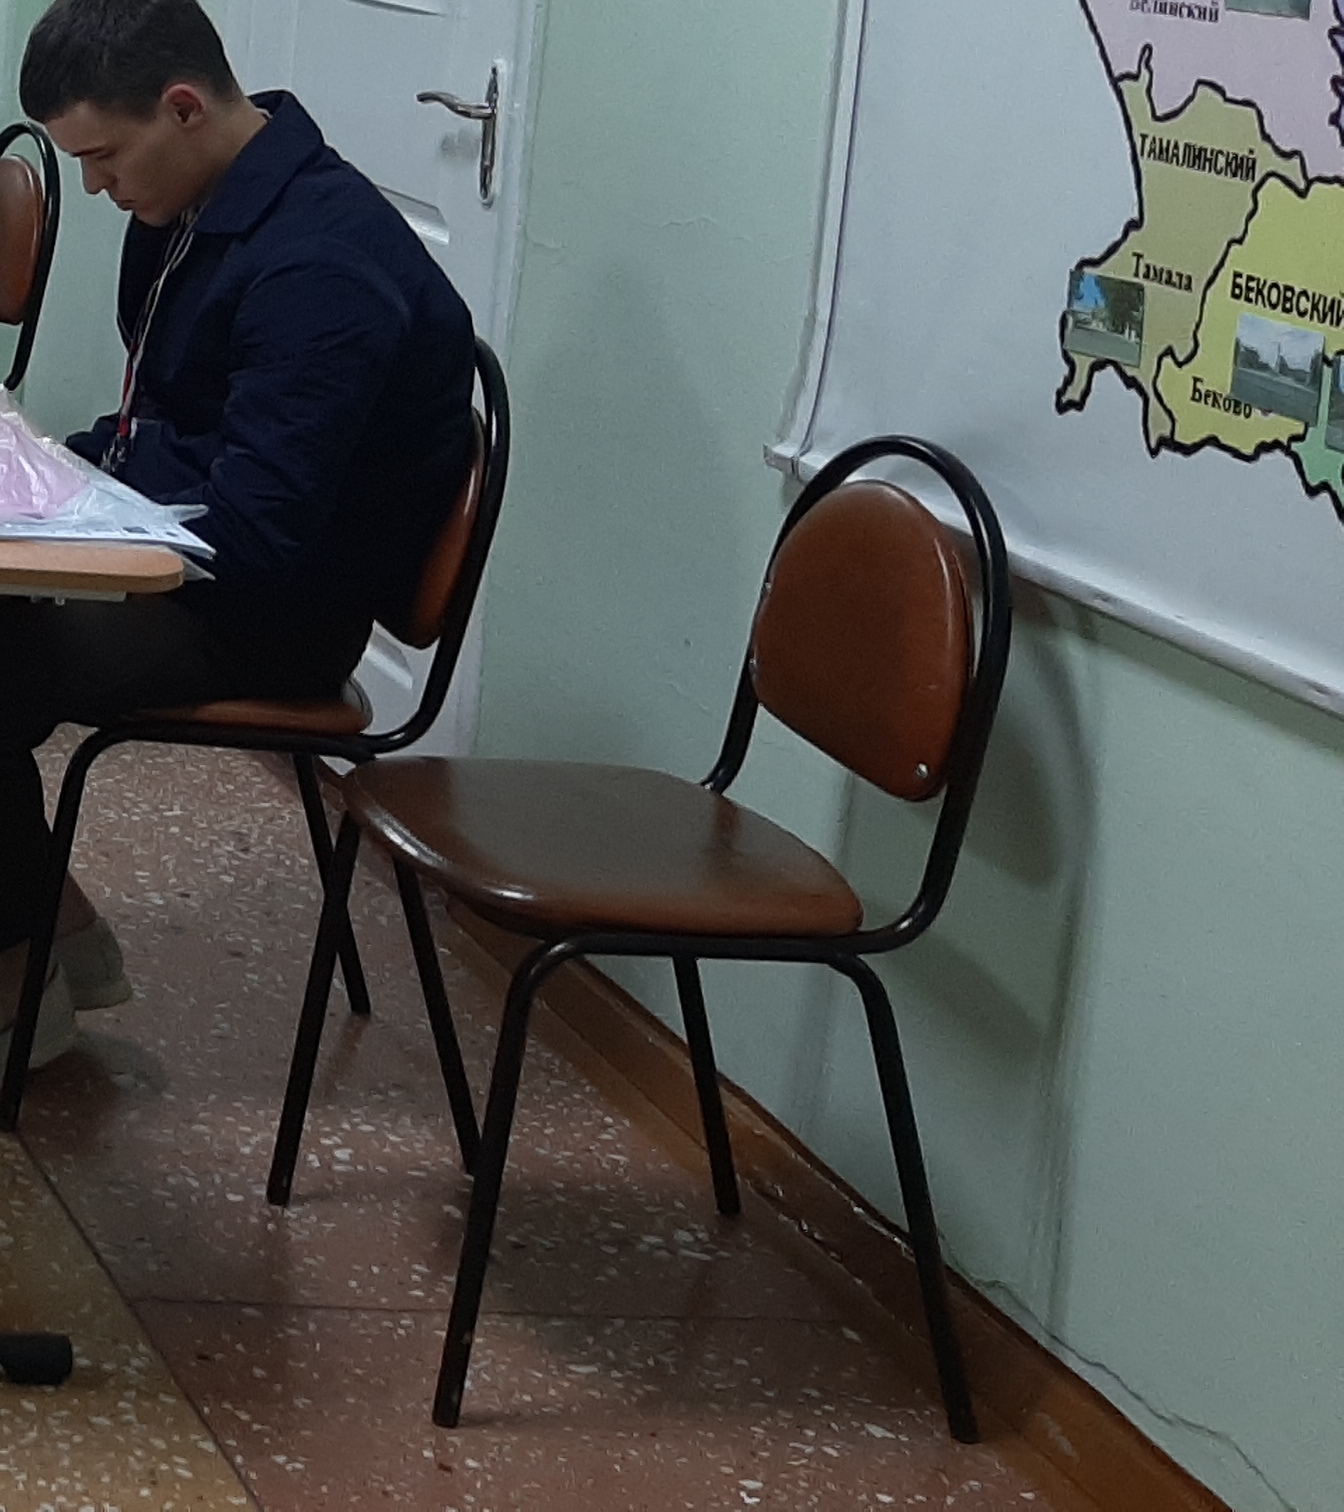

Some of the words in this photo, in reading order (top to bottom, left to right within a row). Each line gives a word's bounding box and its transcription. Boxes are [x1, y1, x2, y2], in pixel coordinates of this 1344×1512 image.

[1140, 133, 1257, 183] ТАМАЛИНСКИЙ
[1132, 251, 1193, 292] Тамала
[1190, 376, 1253, 419] Беково
